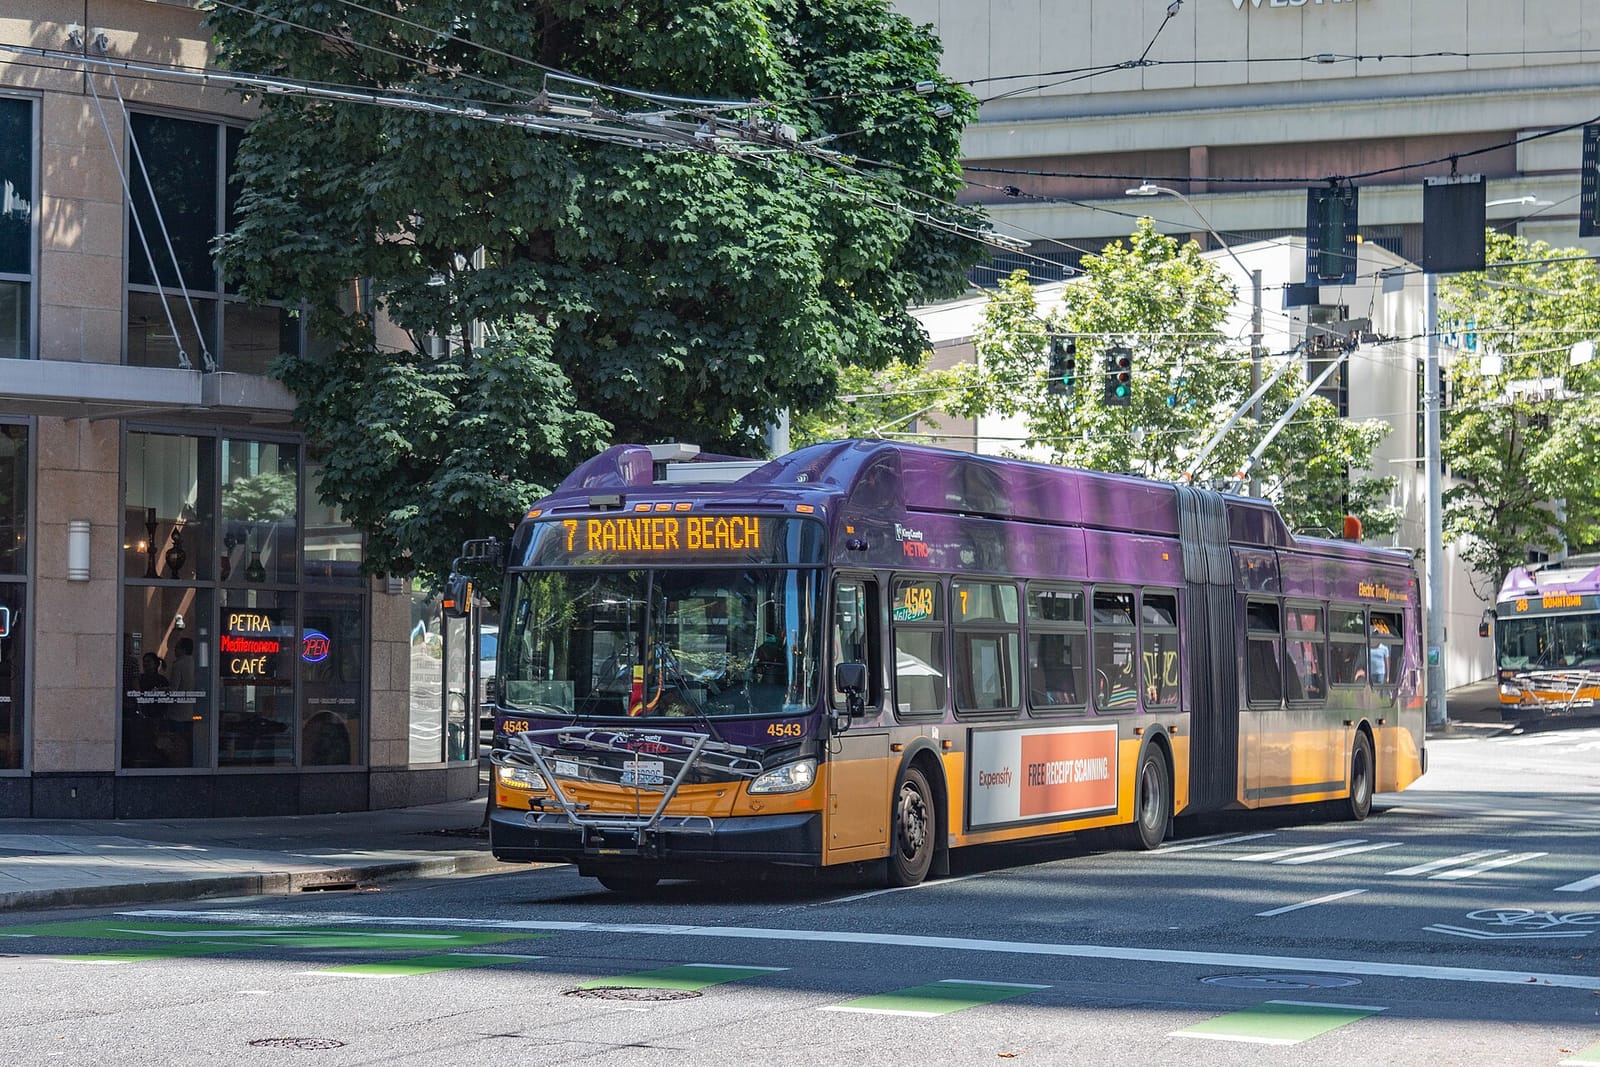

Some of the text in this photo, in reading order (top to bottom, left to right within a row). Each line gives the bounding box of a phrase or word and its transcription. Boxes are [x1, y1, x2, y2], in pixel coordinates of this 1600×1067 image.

[563, 516, 759, 551] 7 RAINIER BEACH
[903, 541, 929, 558] METRO
[905, 588, 932, 615] 4543
[960, 591, 968, 615] 7
[1542, 594, 1582, 609] DOWNTOWN
[229, 614, 271, 632] PETRA
[220, 635, 279, 653] Mediterranean
[303, 639, 331, 657] OPEN
[231, 656, 267, 675] CAFÉ
[502, 721, 529, 733] 4543
[767, 723, 802, 736] 4543
[979, 767, 1012, 788] Expensify
[1028, 763, 1045, 786] FREE
[1045, 760, 1074, 785] RECEIPT
